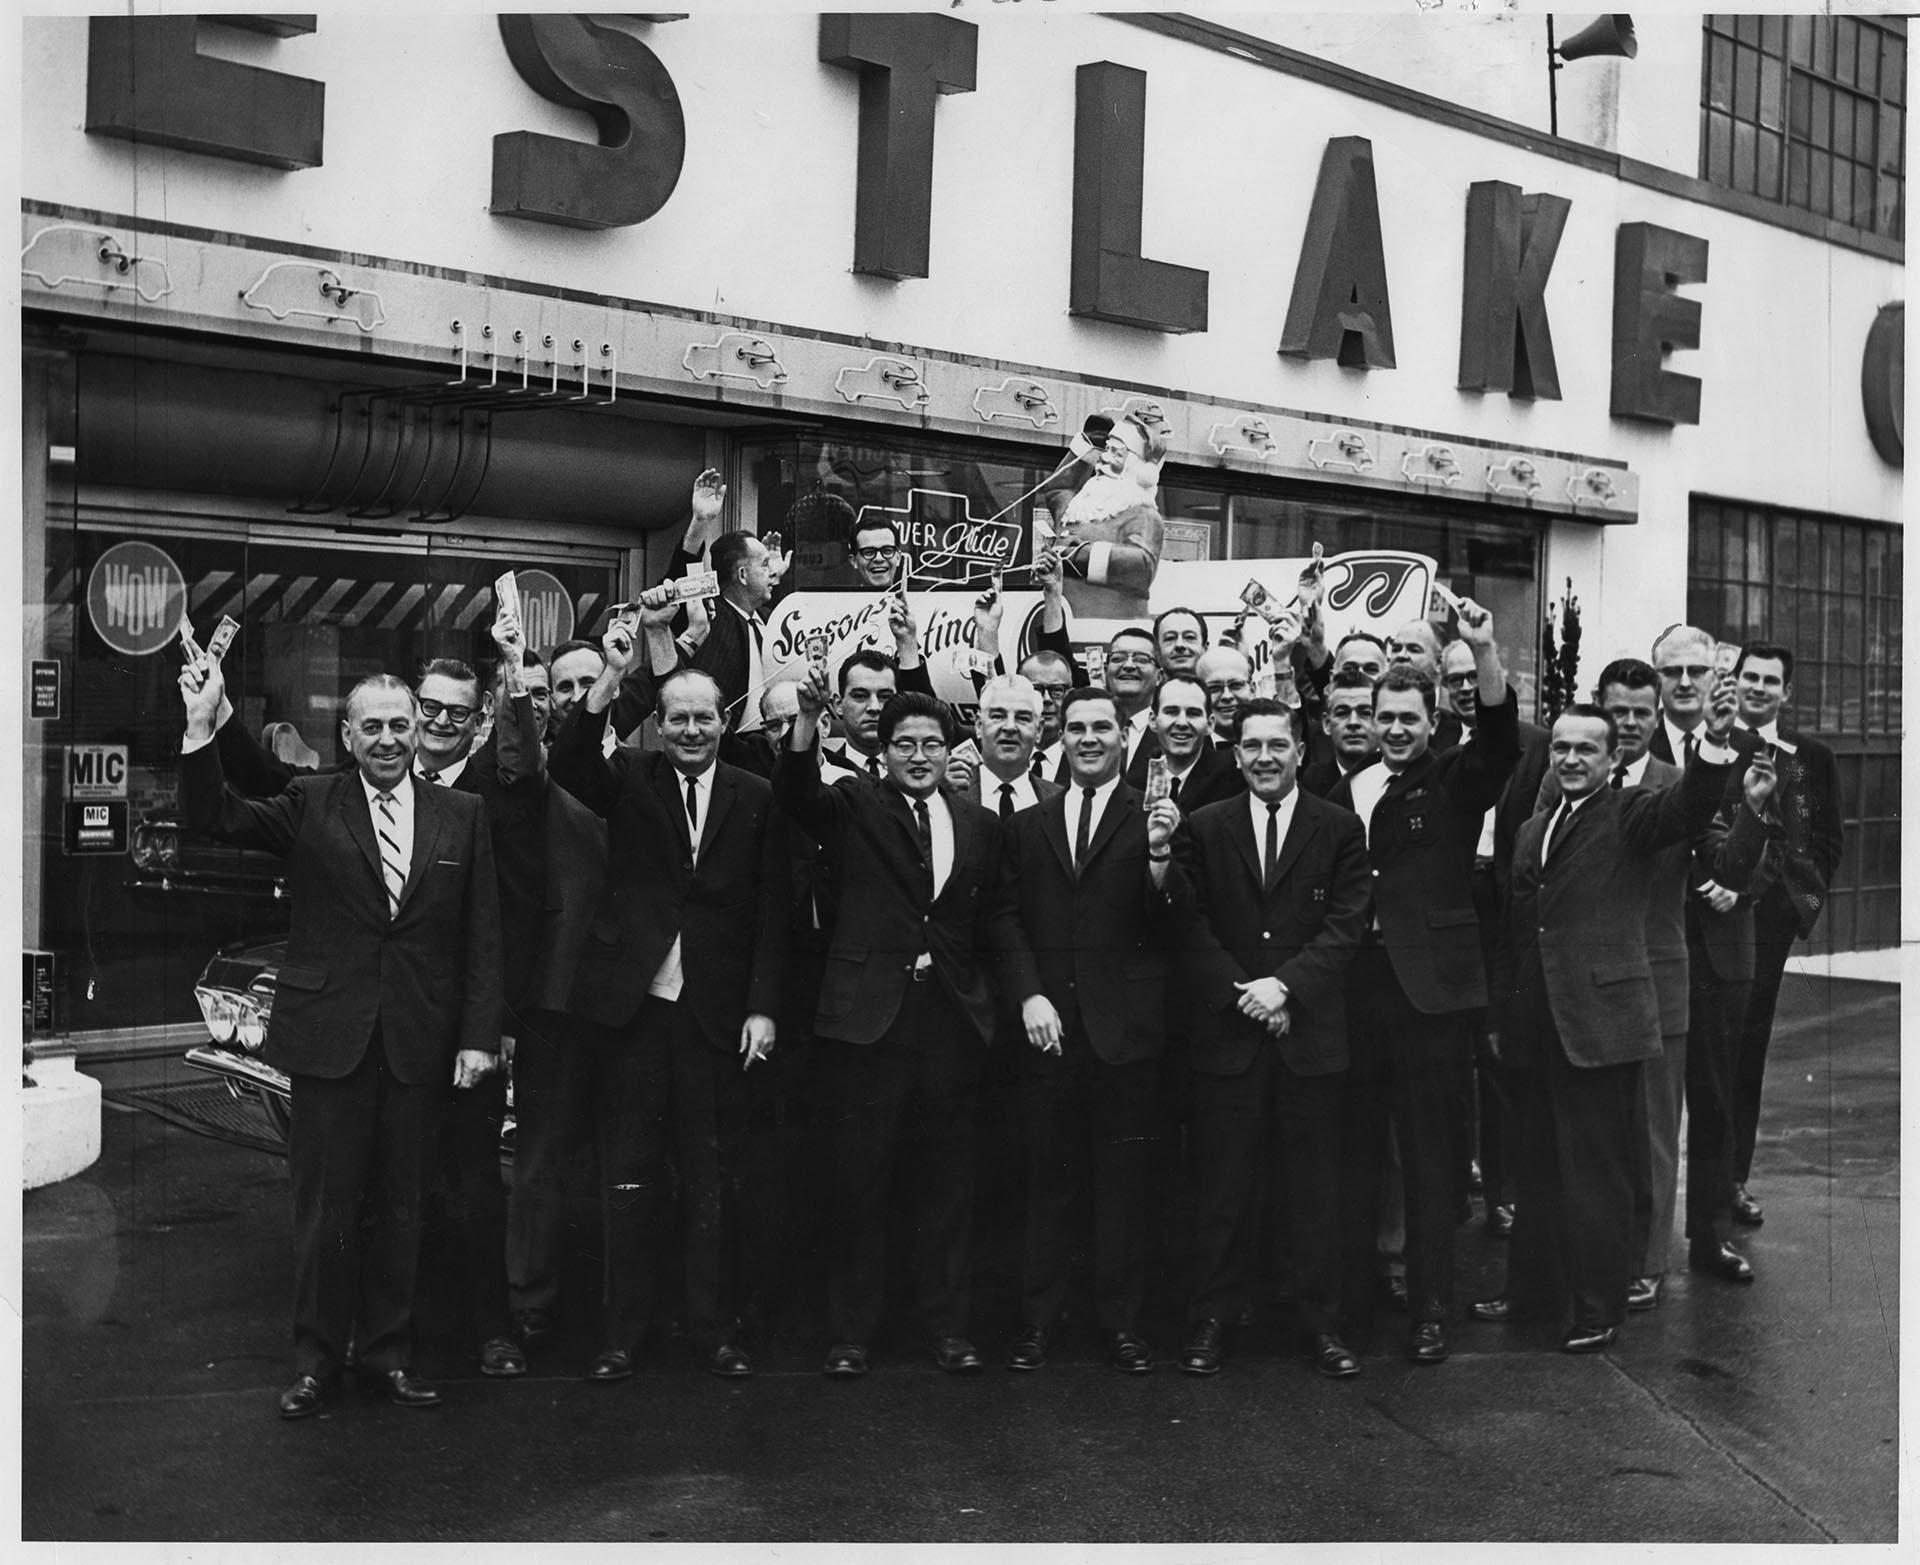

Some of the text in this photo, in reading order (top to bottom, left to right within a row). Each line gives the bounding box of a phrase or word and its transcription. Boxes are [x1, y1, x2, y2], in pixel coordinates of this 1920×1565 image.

[921, 523, 1010, 567] Glide
[105, 563, 168, 635] WOW
[69, 752, 124, 784] MIC
[86, 808, 107, 821] MIC
